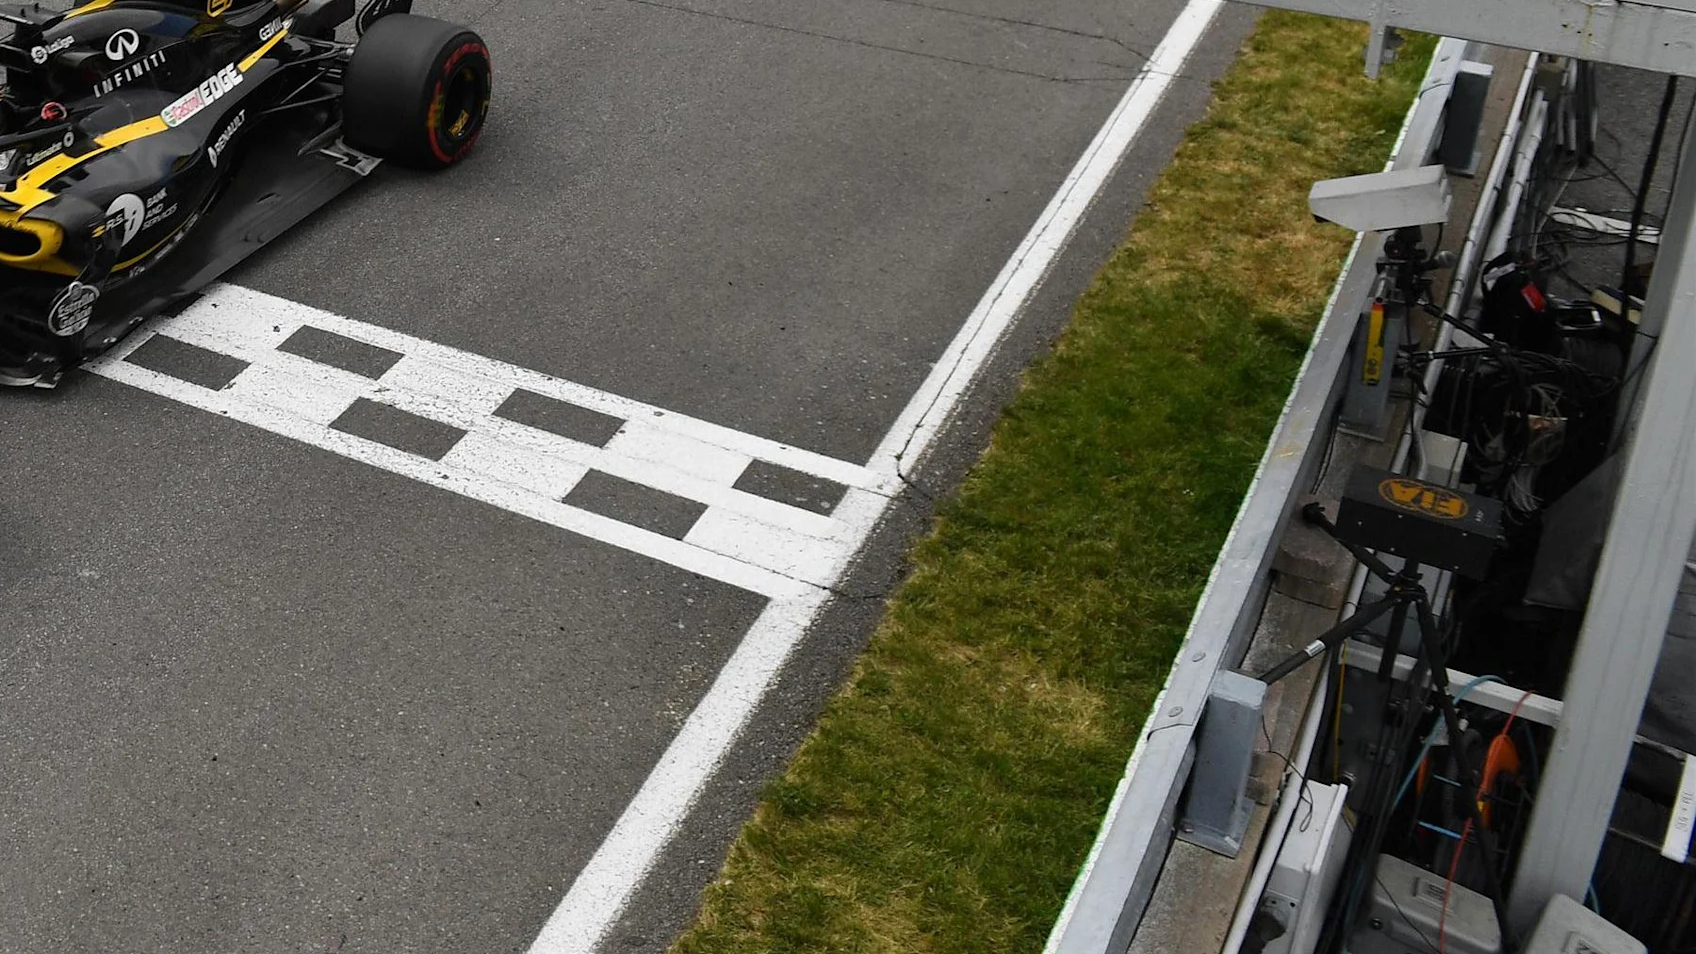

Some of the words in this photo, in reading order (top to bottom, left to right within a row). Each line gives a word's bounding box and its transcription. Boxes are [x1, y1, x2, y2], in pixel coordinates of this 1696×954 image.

[93, 50, 166, 98] INFINITI
[199, 62, 244, 107] EDGE
[214, 109, 245, 156] RENAULT
[1389, 480, 1464, 517] FIA
